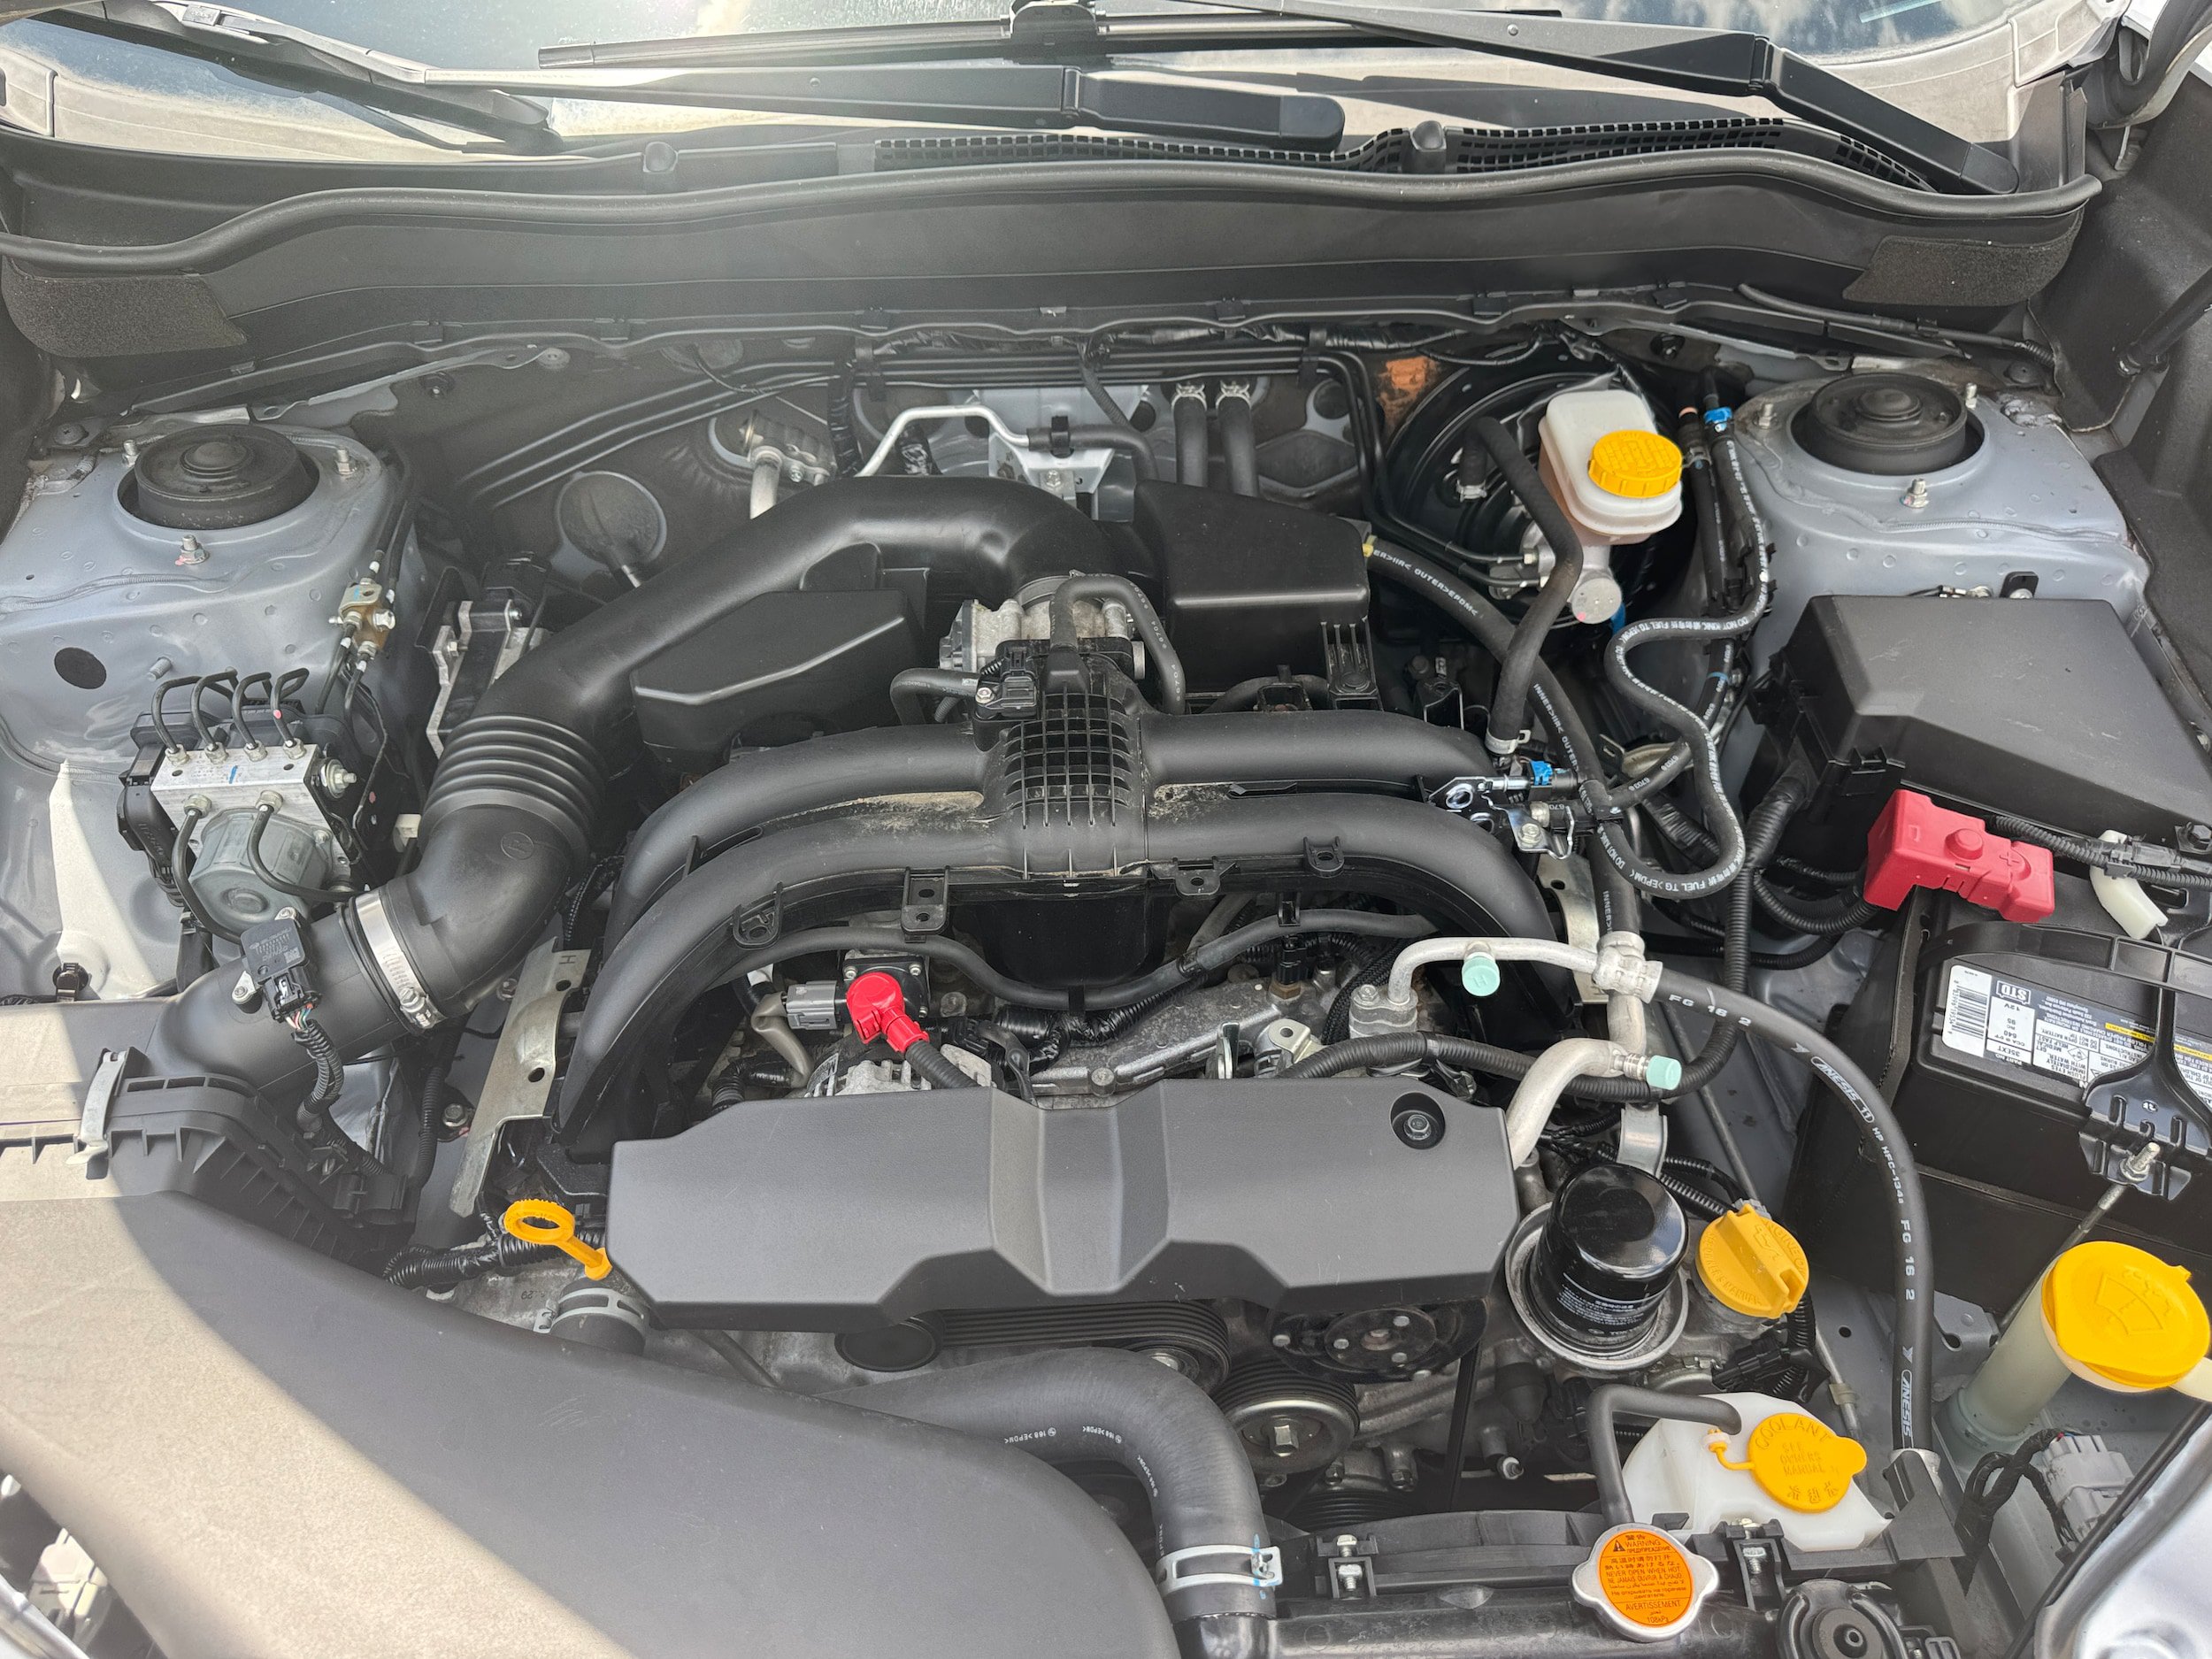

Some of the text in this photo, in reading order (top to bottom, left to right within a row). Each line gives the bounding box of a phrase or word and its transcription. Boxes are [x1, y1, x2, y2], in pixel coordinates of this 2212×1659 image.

[1652, 621, 1669, 630] FUEL
[1607, 847, 1617, 861] NOT
[1615, 858, 1625, 870] DO
[1684, 880, 1705, 891] FUEL
[1999, 983, 2028, 1001] STD
[1668, 994, 1694, 1007] FG
[1738, 1015, 1753, 1027] 2
[2003, 1002, 2020, 1011] 12V
[1996, 1044, 2021, 1057] 35EXT
[1871, 1125, 1884, 1142] HP
[1881, 1145, 1906, 1204] HFC-134a
[1901, 1218, 1911, 1243] FG
[1905, 1256, 1915, 1276] 16
[1724, 1279, 1764, 1307] MANUAL
[1905, 1288, 1915, 1300] 2
[1755, 1417, 1832, 1450] COOLANT
[1624, 1539, 1660, 1548] WARNING
[1625, 1600, 1681, 1610] AVERTISSEMENT
